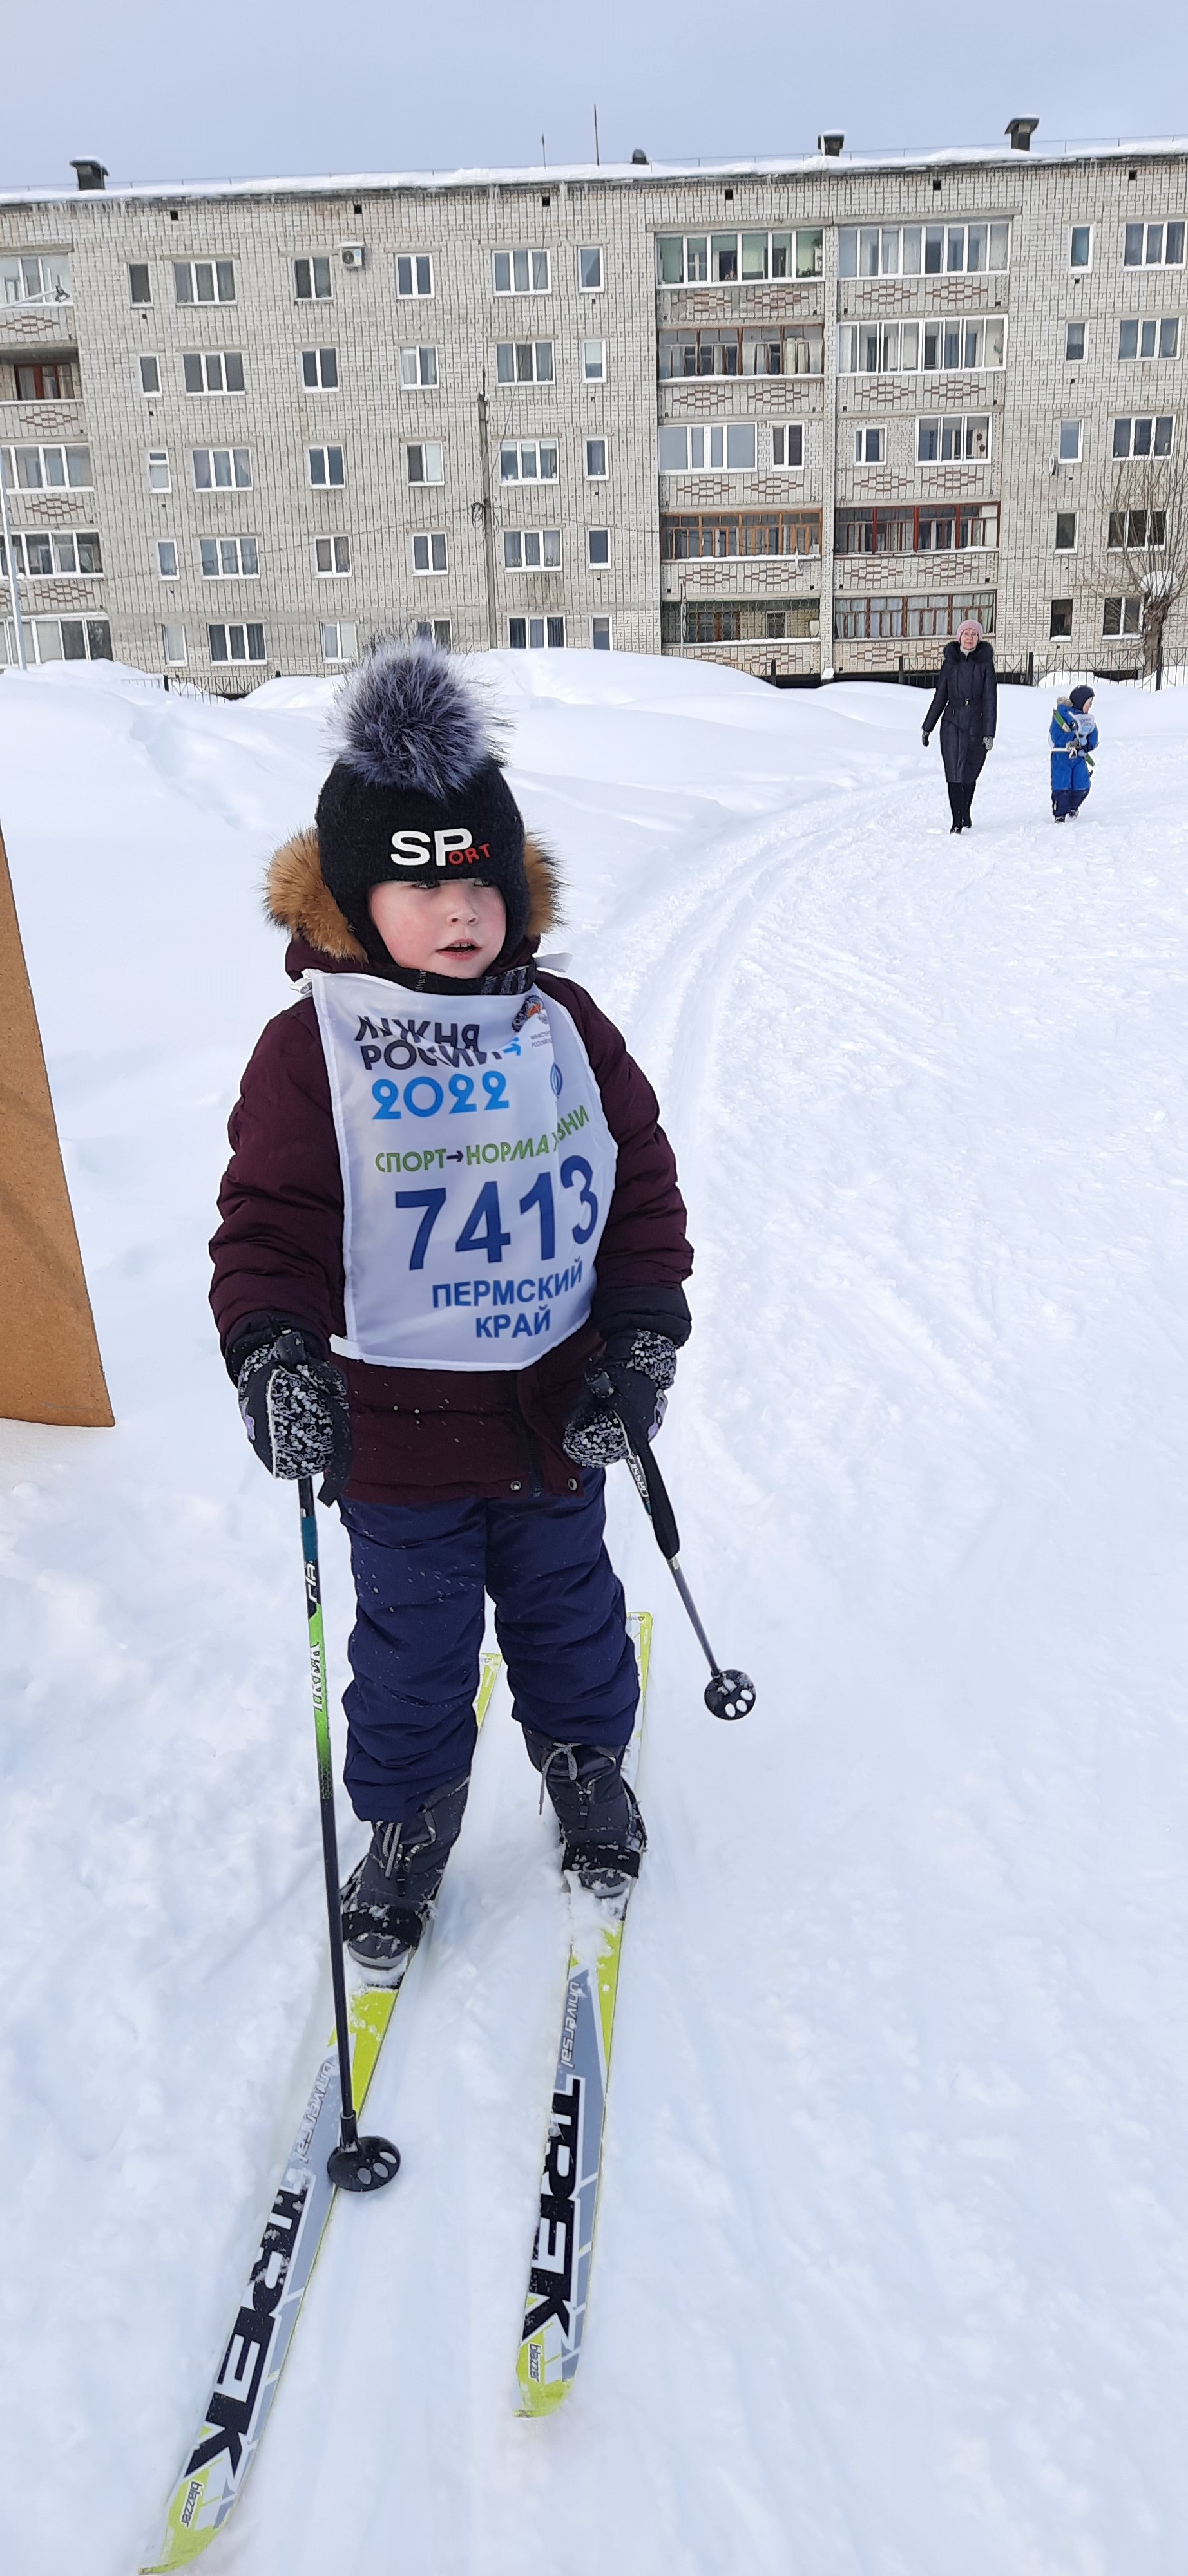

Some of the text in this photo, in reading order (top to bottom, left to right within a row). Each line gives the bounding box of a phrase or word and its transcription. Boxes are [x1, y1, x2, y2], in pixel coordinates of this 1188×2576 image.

[372, 1070, 510, 1120] 2022
[375, 1148, 447, 1173] СПОРТ
[466, 1133, 549, 1166] НОРМА
[395, 1155, 599, 1271] 7413
[432, 1256, 583, 1308] ПЕРМСКИЙ
[475, 1305, 551, 1338] КРАЙ
